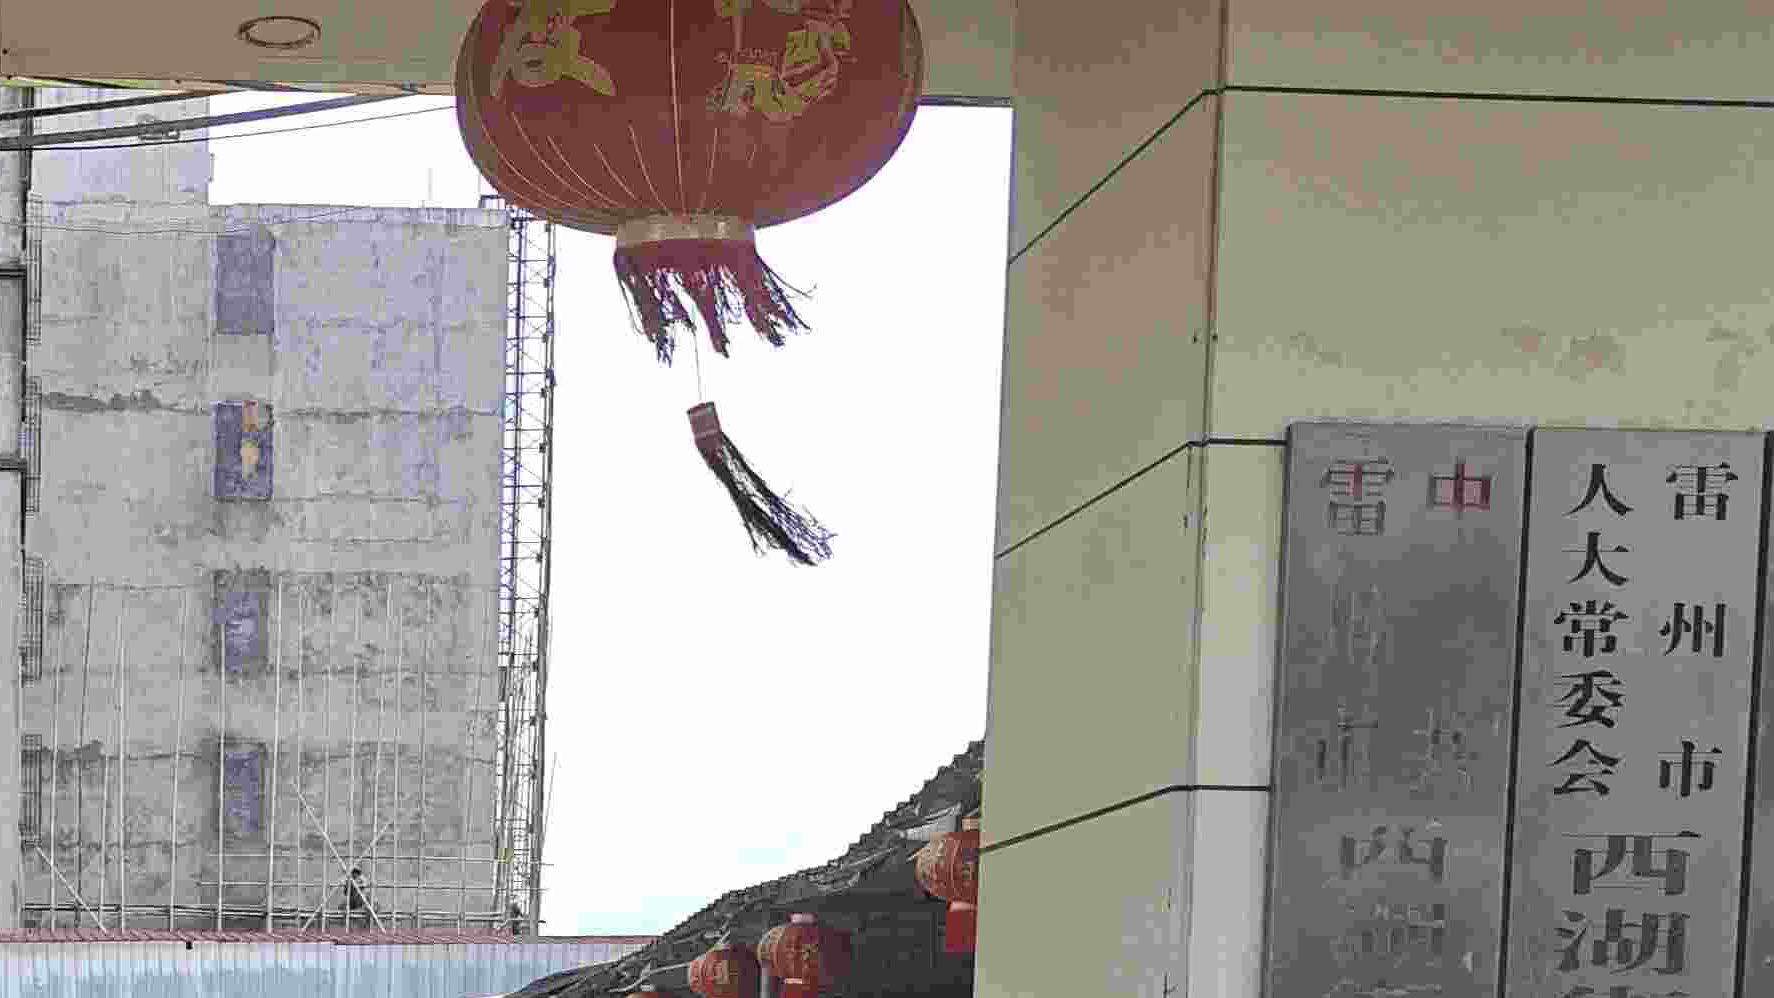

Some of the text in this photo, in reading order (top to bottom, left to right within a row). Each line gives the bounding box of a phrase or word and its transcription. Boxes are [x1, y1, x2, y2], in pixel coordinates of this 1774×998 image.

[1314, 459, 1395, 790] 雷市
[1547, 463, 1634, 797] 人大常委会
[1658, 461, 1739, 799] 雷州市
